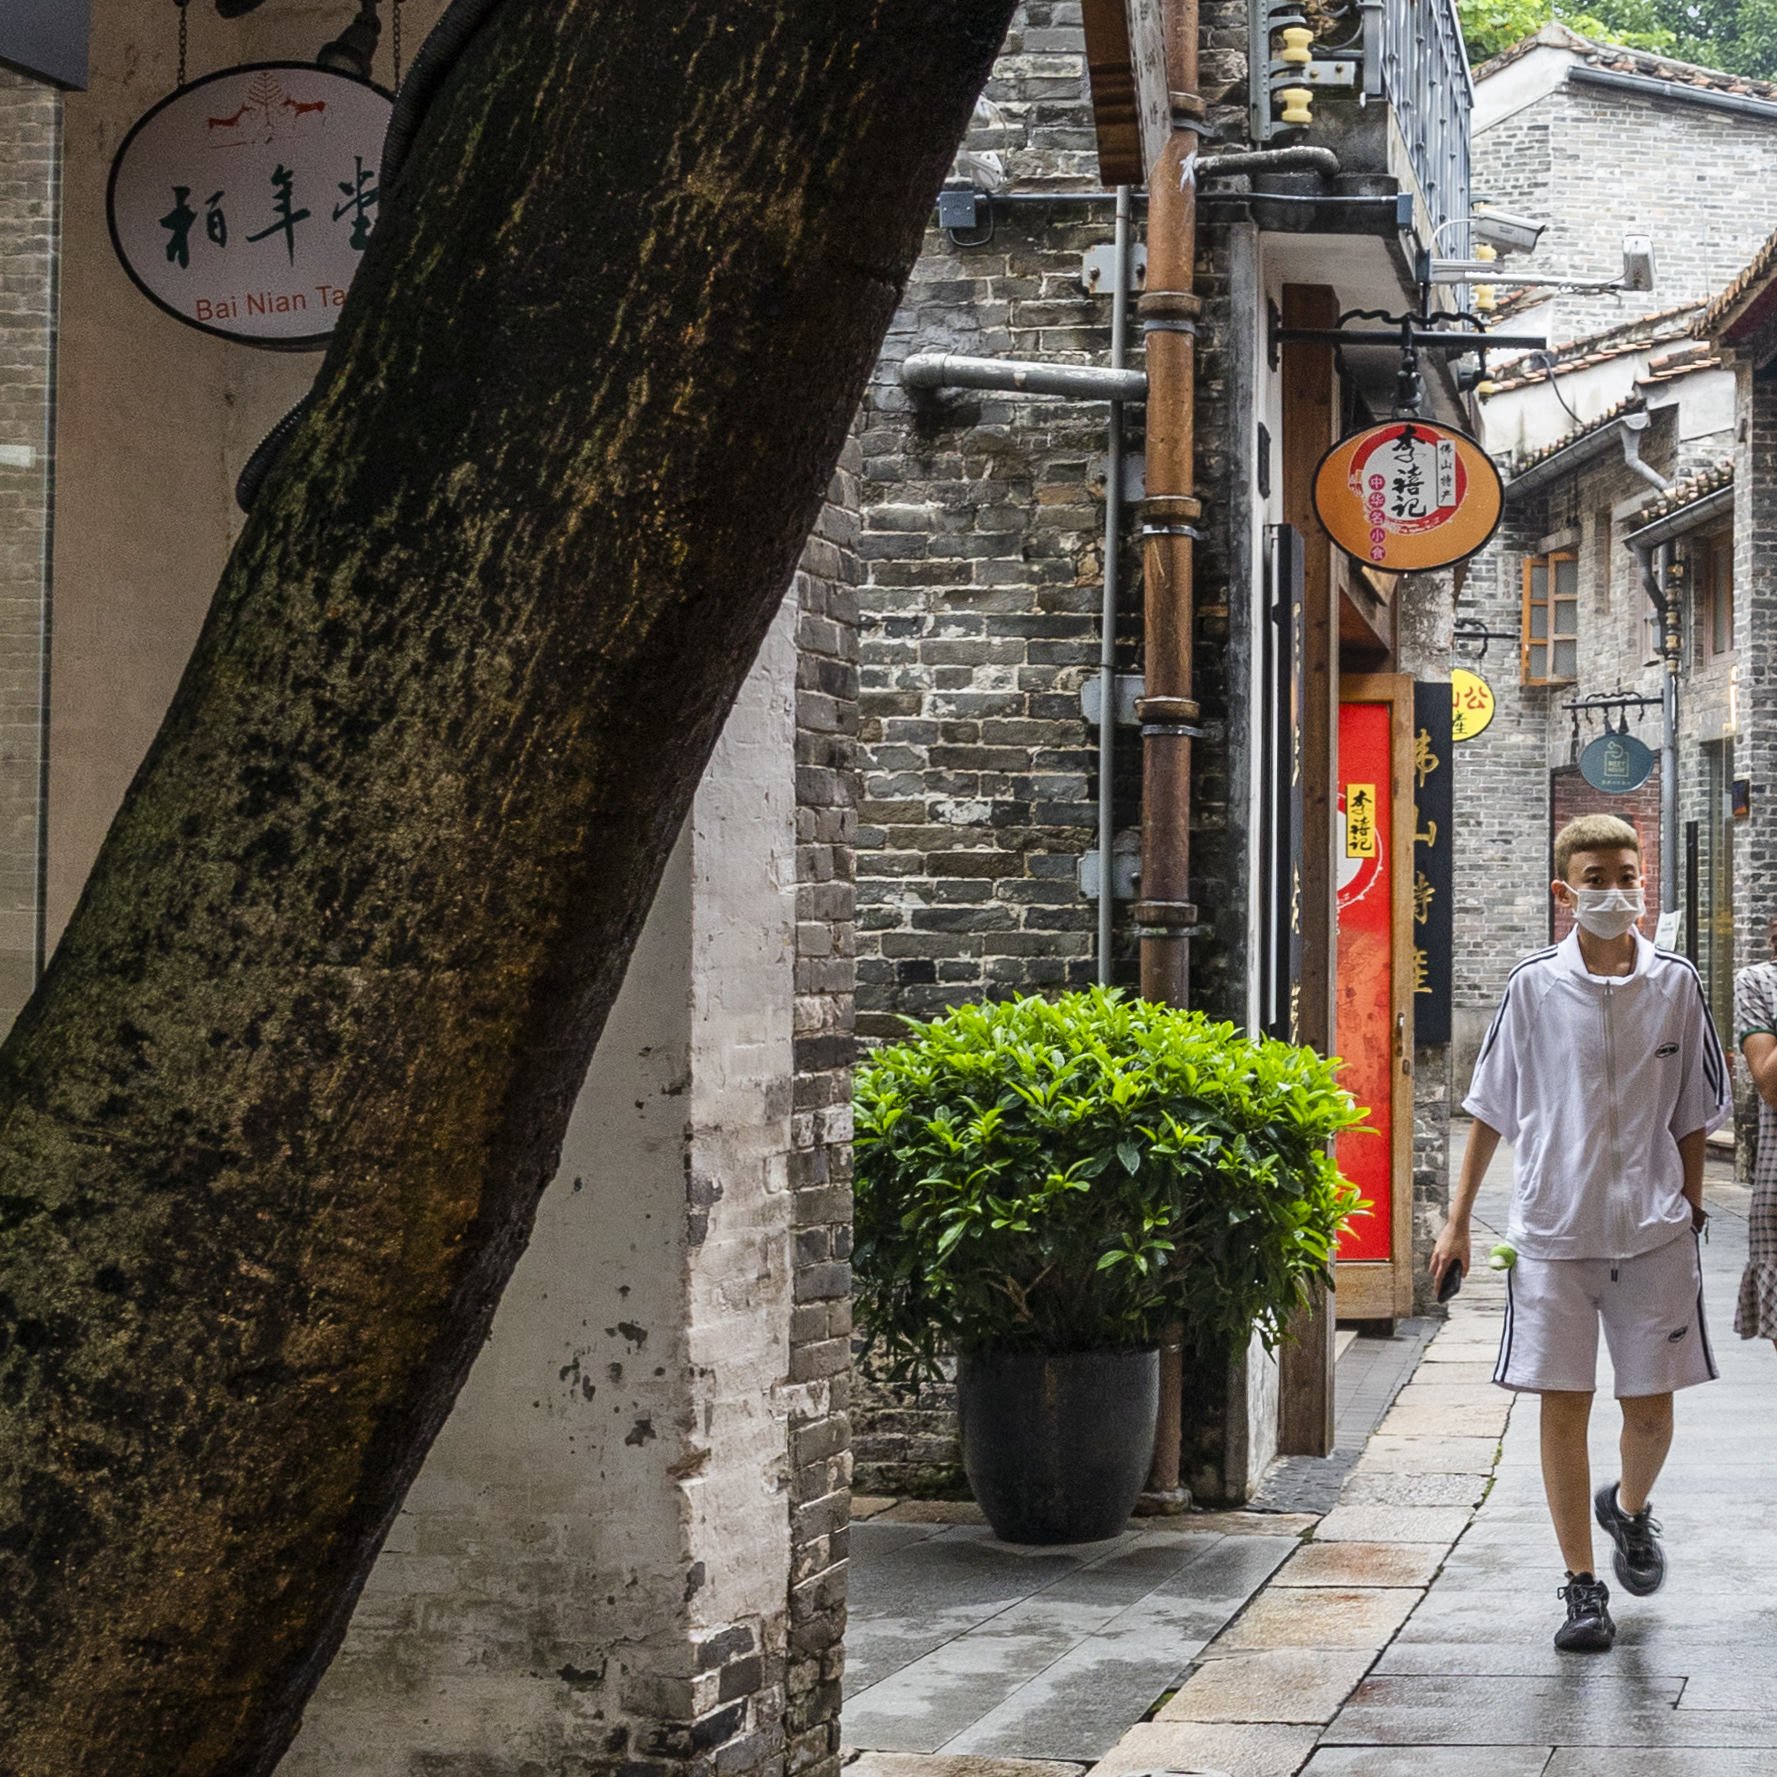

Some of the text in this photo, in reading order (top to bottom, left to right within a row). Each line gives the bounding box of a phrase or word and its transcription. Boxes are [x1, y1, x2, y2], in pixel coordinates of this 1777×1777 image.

[195, 295, 237, 321] Bai
[246, 291, 307, 315] Nian
[1439, 443, 1453, 503] 佛山特产
[1369, 475, 1386, 560] 中华名小食
